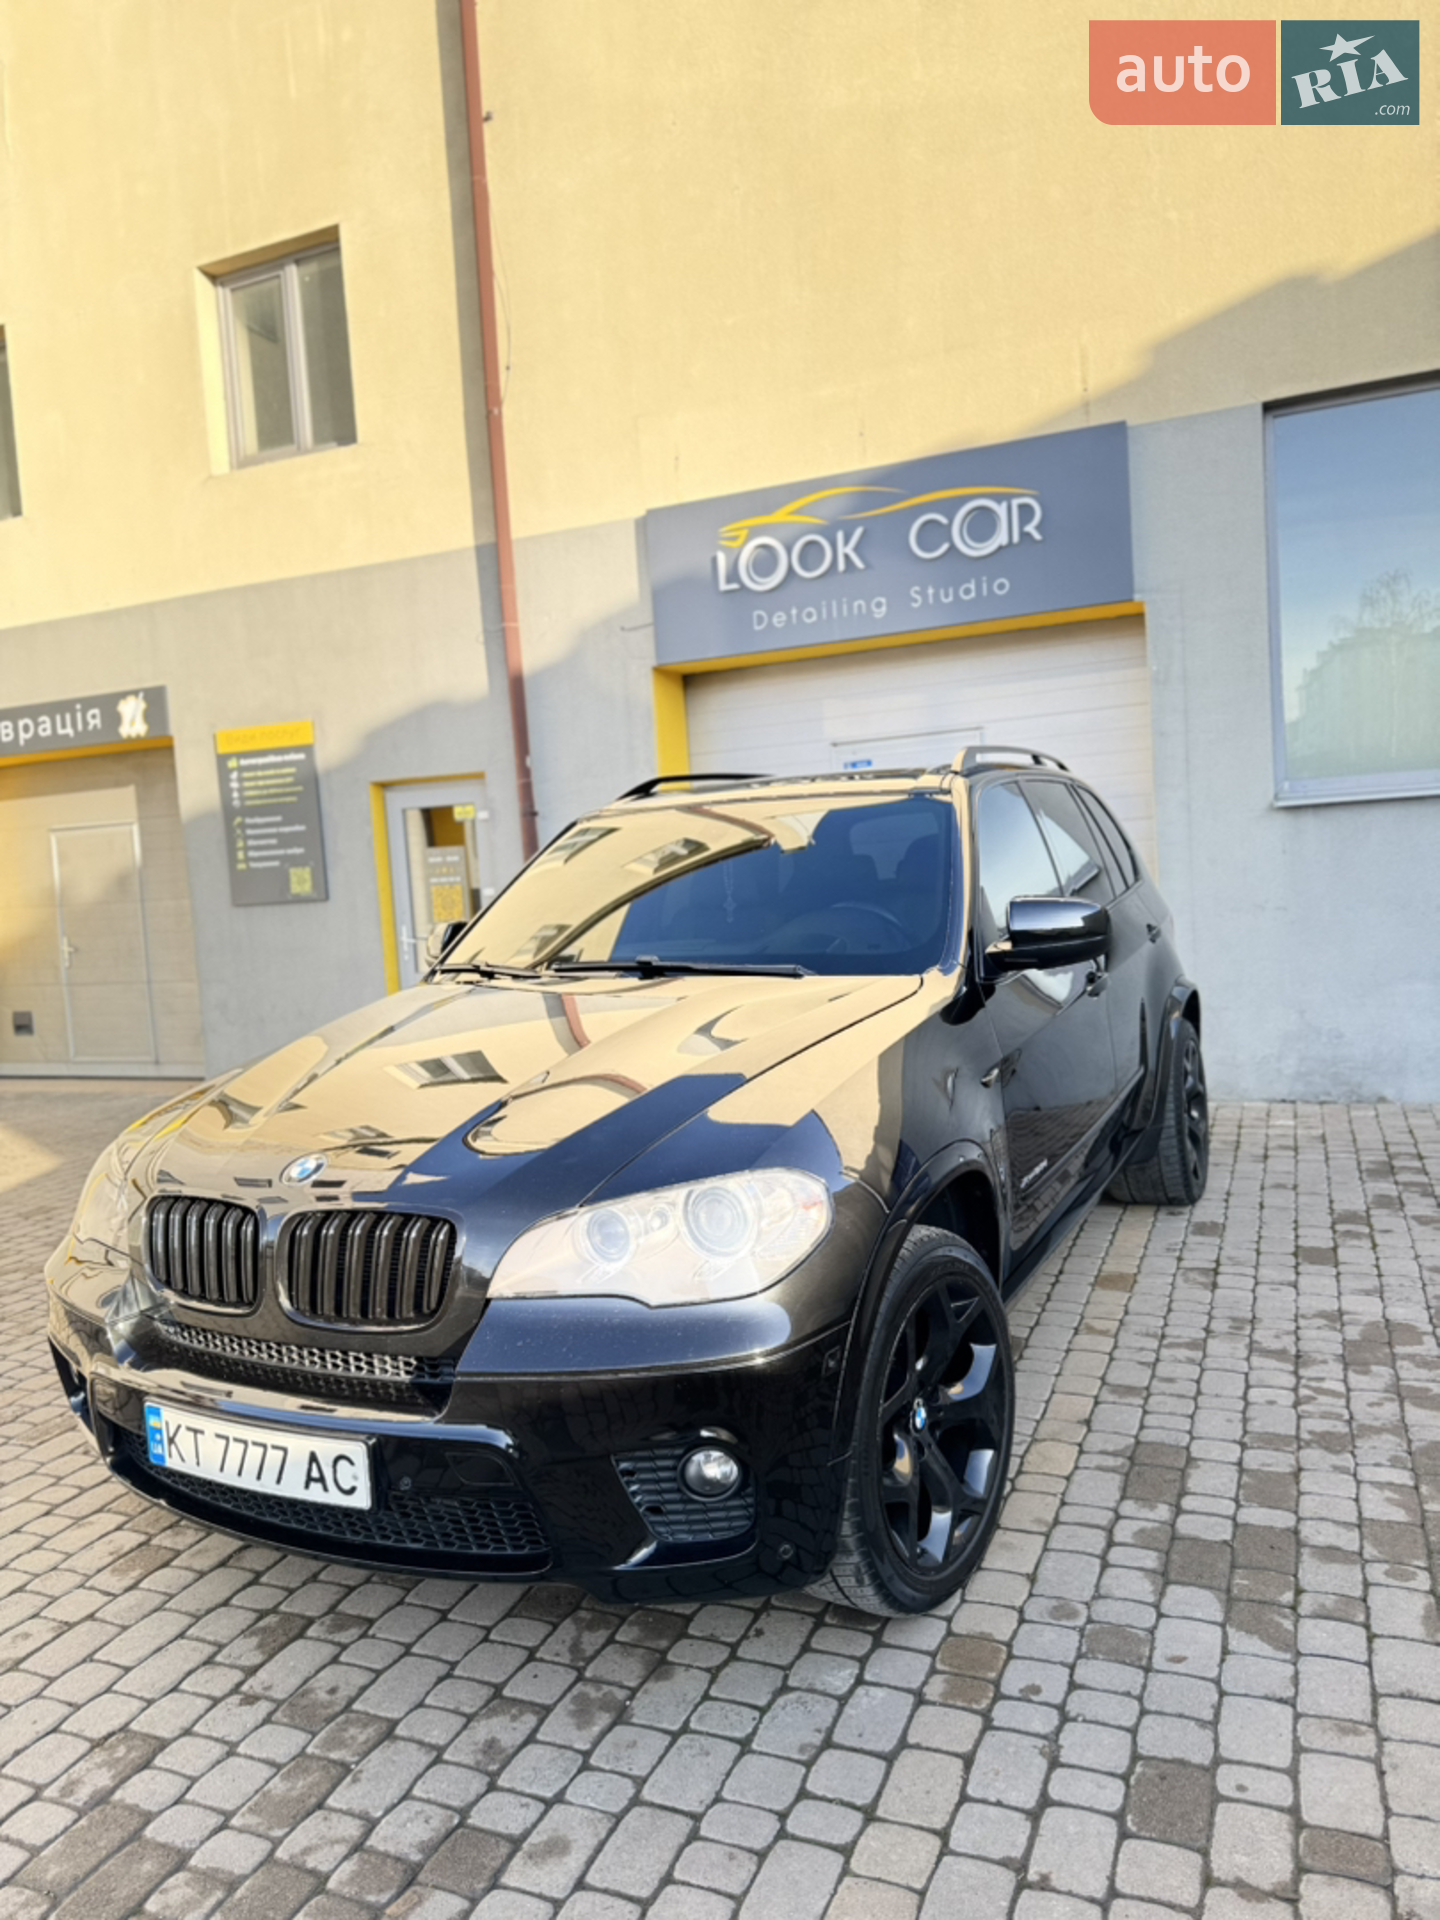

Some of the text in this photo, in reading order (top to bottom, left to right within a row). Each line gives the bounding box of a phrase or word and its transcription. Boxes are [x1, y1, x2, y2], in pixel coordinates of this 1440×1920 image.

[716, 526, 866, 592] LOOK
[752, 575, 1011, 631] Detailing Studio
[0, 703, 102, 747] врація
[164, 1420, 358, 1496] KT 7777 AC
